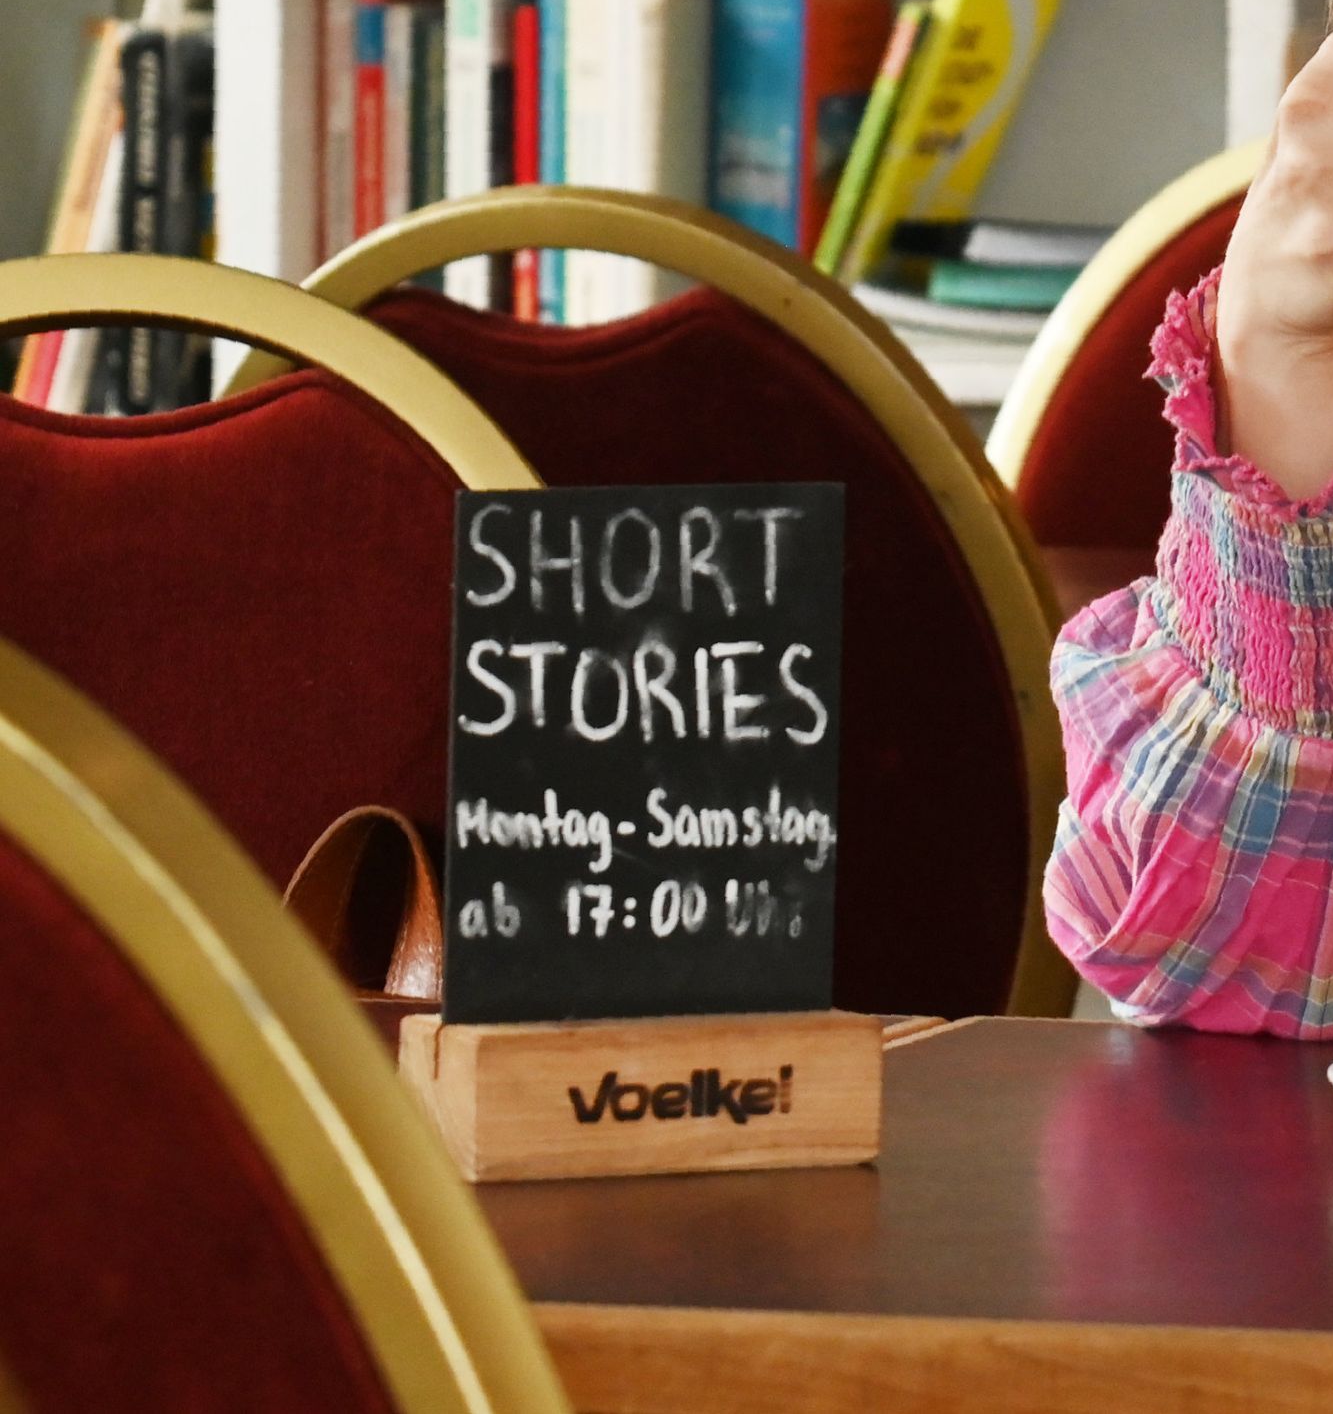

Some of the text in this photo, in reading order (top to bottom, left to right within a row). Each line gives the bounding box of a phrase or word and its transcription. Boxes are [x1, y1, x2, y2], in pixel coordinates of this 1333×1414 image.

[466, 503, 803, 615] SHORT
[458, 637, 828, 744] STORIES
[459, 882, 521, 938] ab
[566, 879, 708, 938] 17:00
